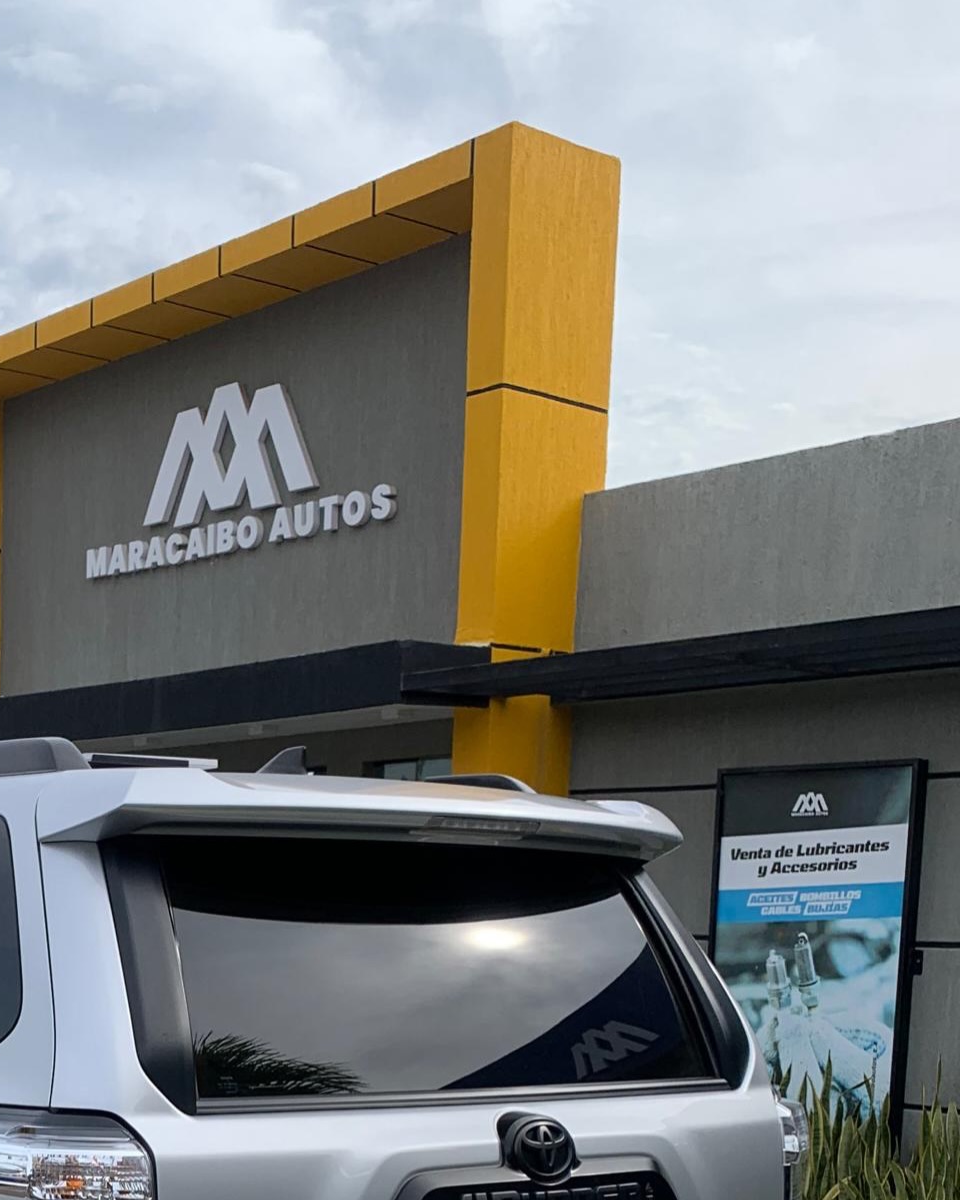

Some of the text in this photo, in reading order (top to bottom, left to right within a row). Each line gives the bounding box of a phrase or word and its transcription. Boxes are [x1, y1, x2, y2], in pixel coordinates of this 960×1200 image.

[86, 483, 397, 579] MARACAIBO AUTOS
[731, 840, 890, 861] Venta de Lubricantes
[757, 859, 858, 878] y Accesorios
